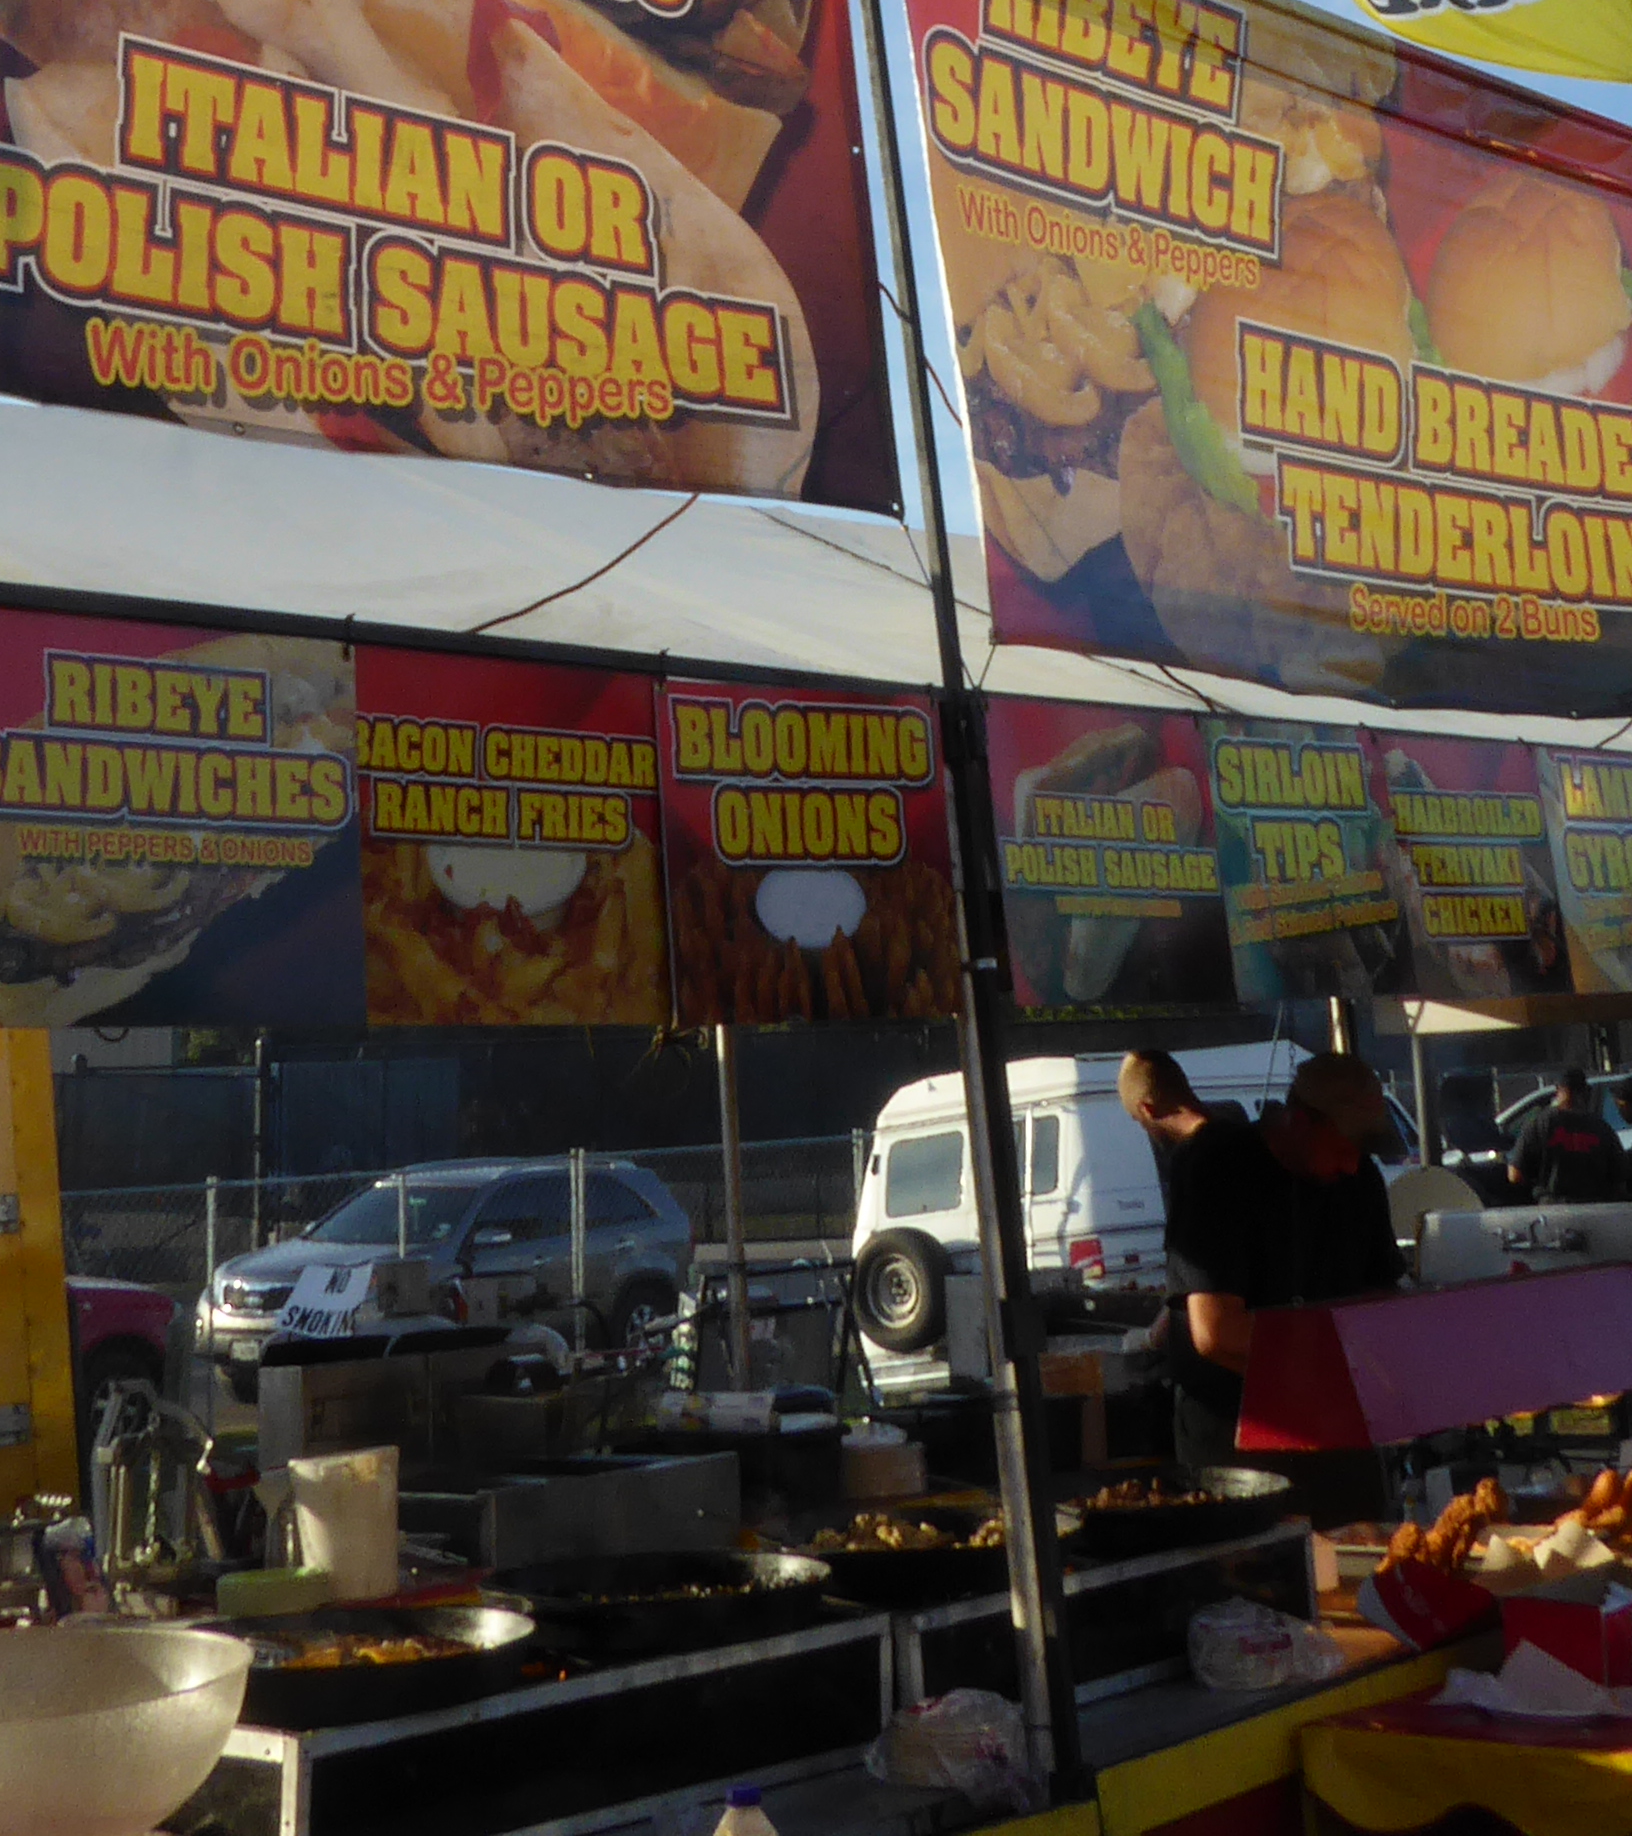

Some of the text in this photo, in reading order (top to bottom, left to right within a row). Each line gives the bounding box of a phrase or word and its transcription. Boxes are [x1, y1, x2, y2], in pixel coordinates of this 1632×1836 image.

[125, 50, 650, 270] ITALIAN OR
[930, 37, 1279, 254] SANDWICH
[957, 185, 1260, 294] With Onions & Peppers
[373, 242, 780, 410] SAUSAGE
[87, 317, 674, 428] With Onions & Peppers
[1242, 333, 1405, 462] HAND
[1349, 588, 1601, 642] Served on 2 Buns
[51, 659, 266, 739] RIBEYE
[483, 730, 657, 789] CHEDDAR
[673, 704, 931, 781] BLOOMING
[1216, 743, 1366, 809] SIRLOIN
[374, 780, 630, 844] RANCH FRIES
[716, 790, 903, 861] ONIONS
[1034, 796, 1177, 845] ITALIAN OR
[1391, 792, 1542, 837] HARBROILED
[18, 827, 313, 868] WITH PEPPERS & ONIONS
[1004, 843, 1099, 888] POLISH
[1103, 848, 1218, 892] SAUSAGE
[1252, 820, 1346, 882] TIPS
[1411, 844, 1525, 887] TERIYAKI
[1423, 892, 1529, 938] CHICKEN
[324, 1266, 352, 1294] NO
